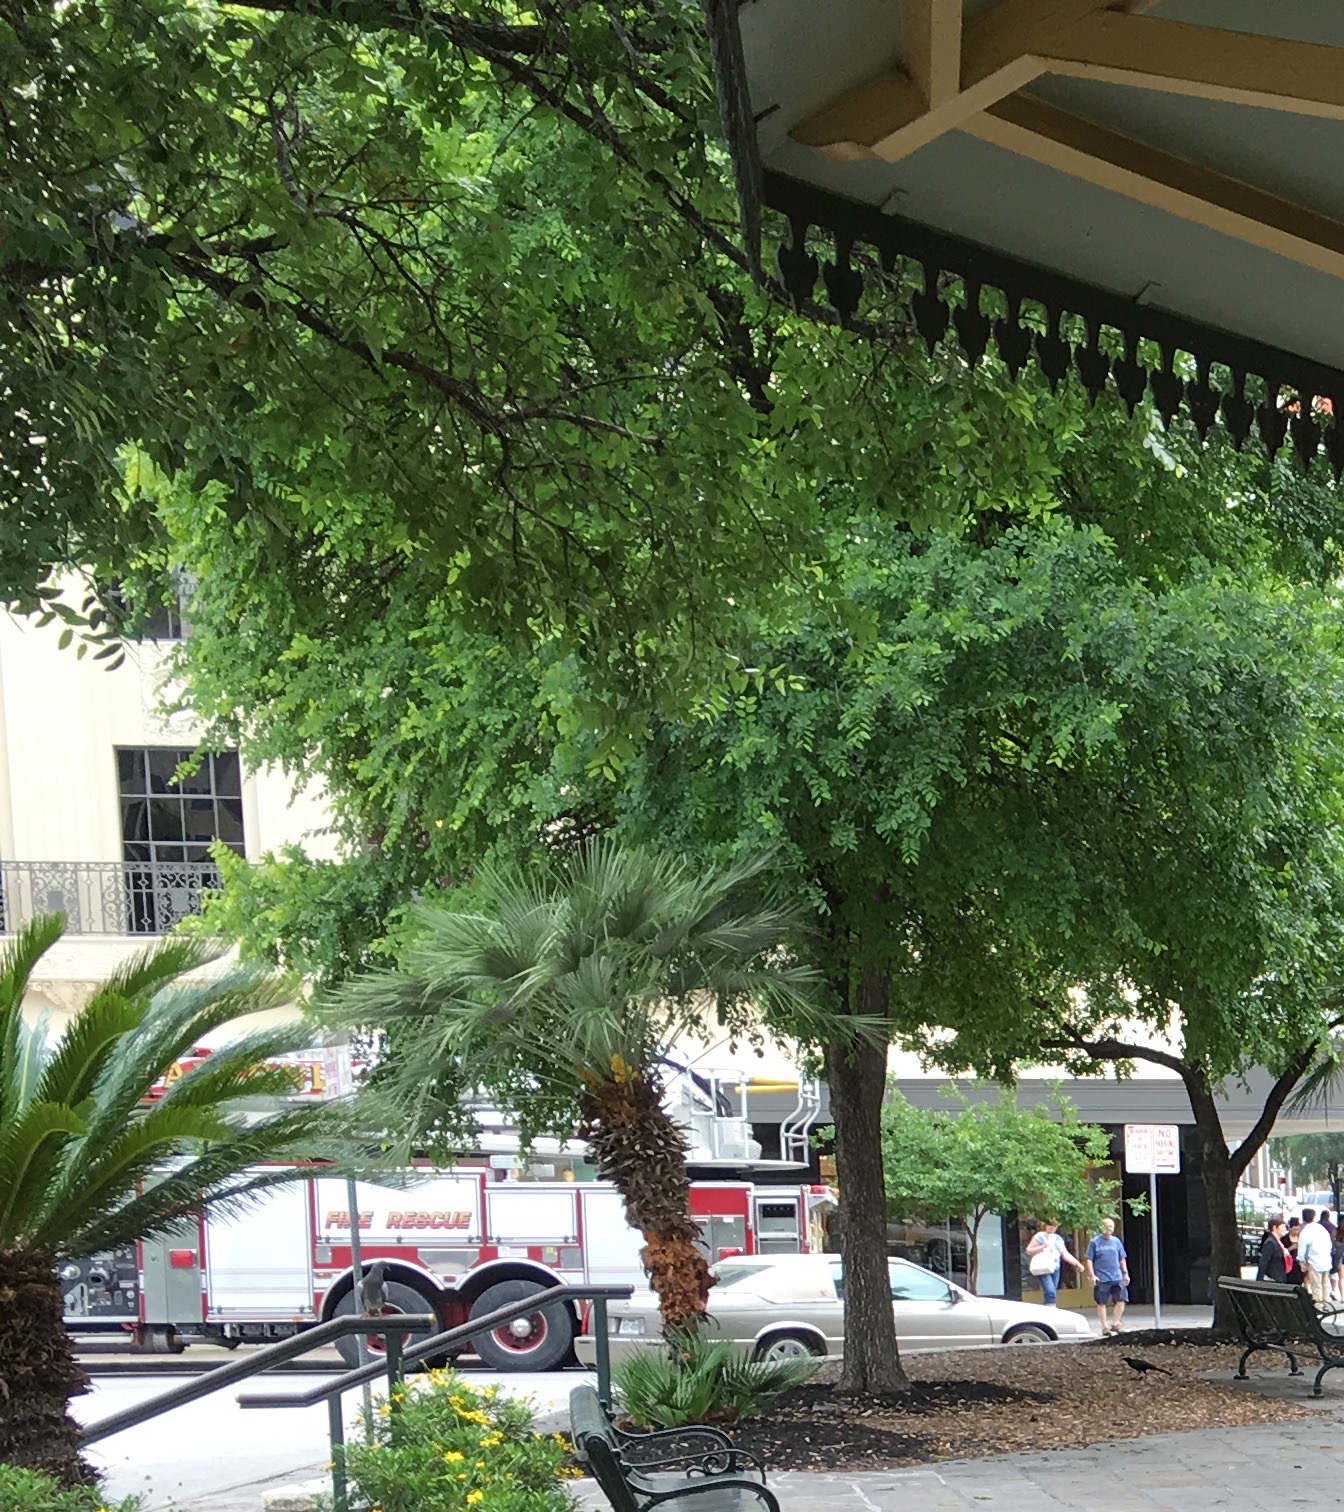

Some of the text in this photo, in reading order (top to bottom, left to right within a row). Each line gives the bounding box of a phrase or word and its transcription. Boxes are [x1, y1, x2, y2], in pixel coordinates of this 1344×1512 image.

[1158, 1129, 1172, 1138] NO
[324, 1210, 473, 1230] FIE RESCUE
